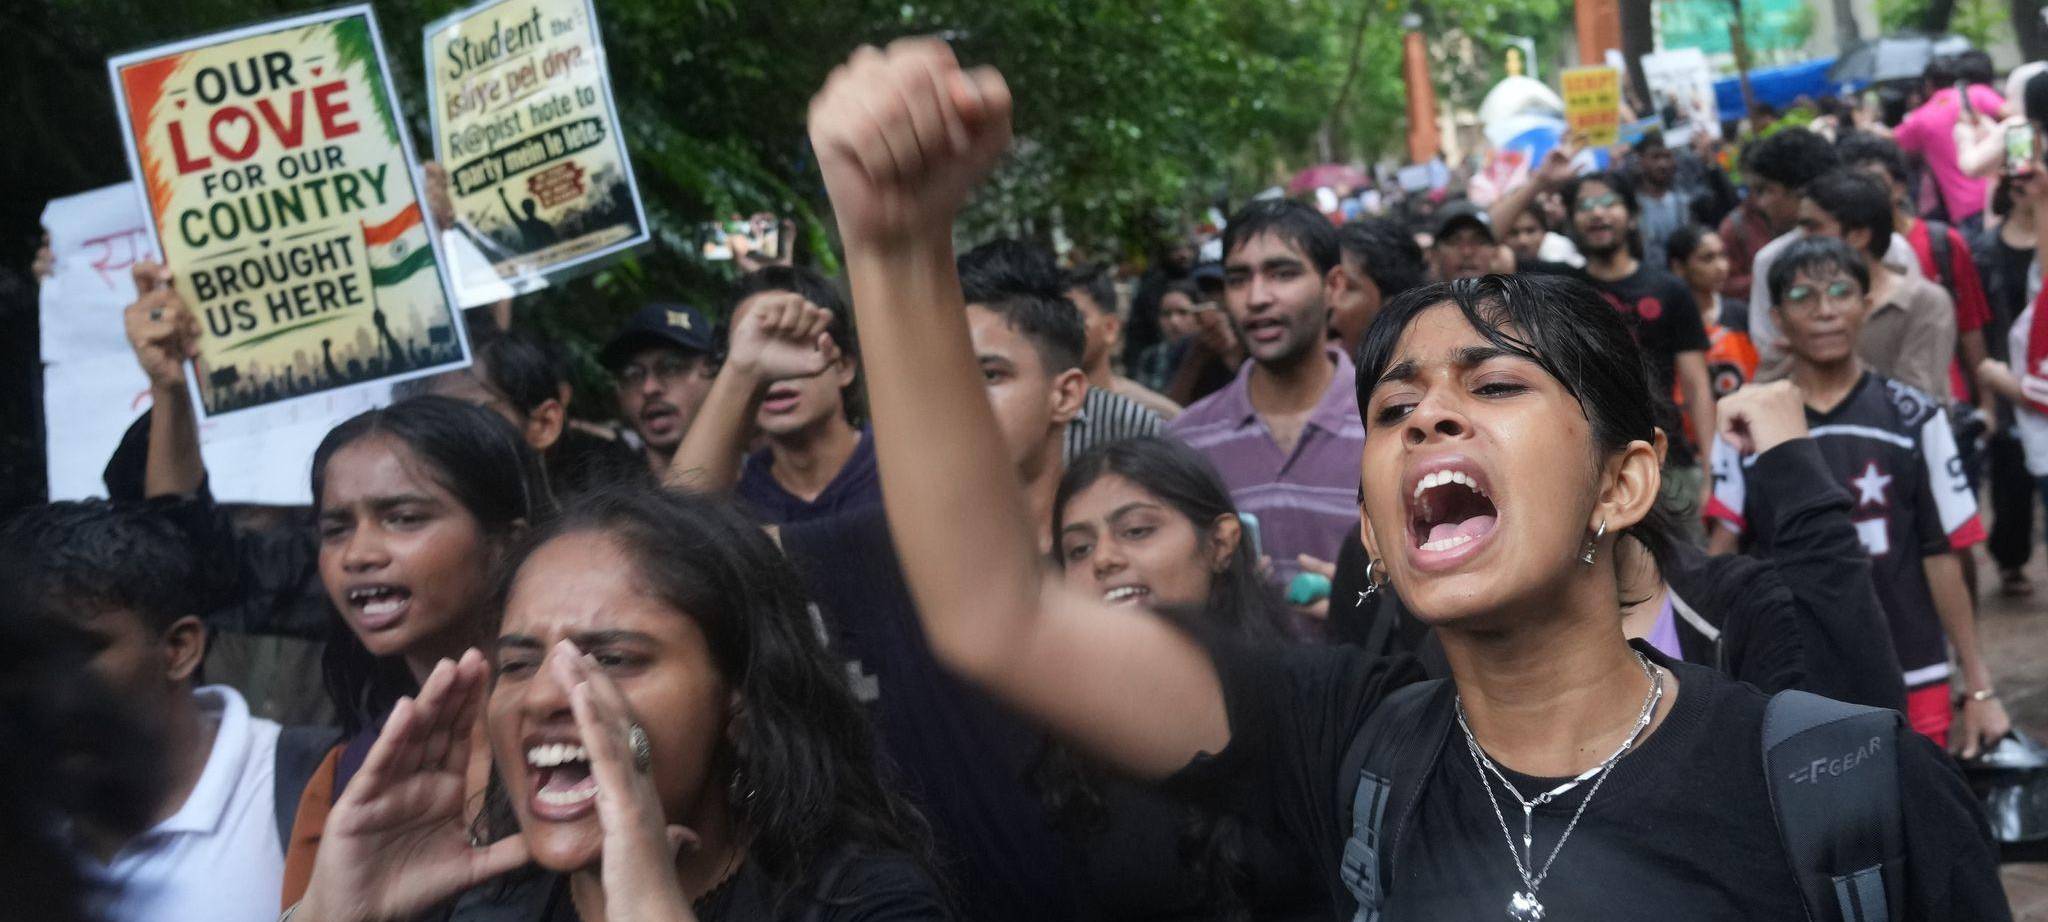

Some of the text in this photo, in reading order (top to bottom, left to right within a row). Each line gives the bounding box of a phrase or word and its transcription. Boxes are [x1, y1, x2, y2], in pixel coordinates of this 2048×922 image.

[449, 7, 544, 80] Student
[195, 50, 298, 106] OUR
[506, 58, 539, 101] pel
[167, 80, 361, 176] LOVE
[450, 84, 596, 160] R@pist hote to
[202, 145, 346, 200] FOR OUR
[456, 154, 504, 196] party
[180, 163, 390, 249] COUNTRY
[190, 235, 356, 302] BROUGHT
[205, 273, 365, 338] US HERE
